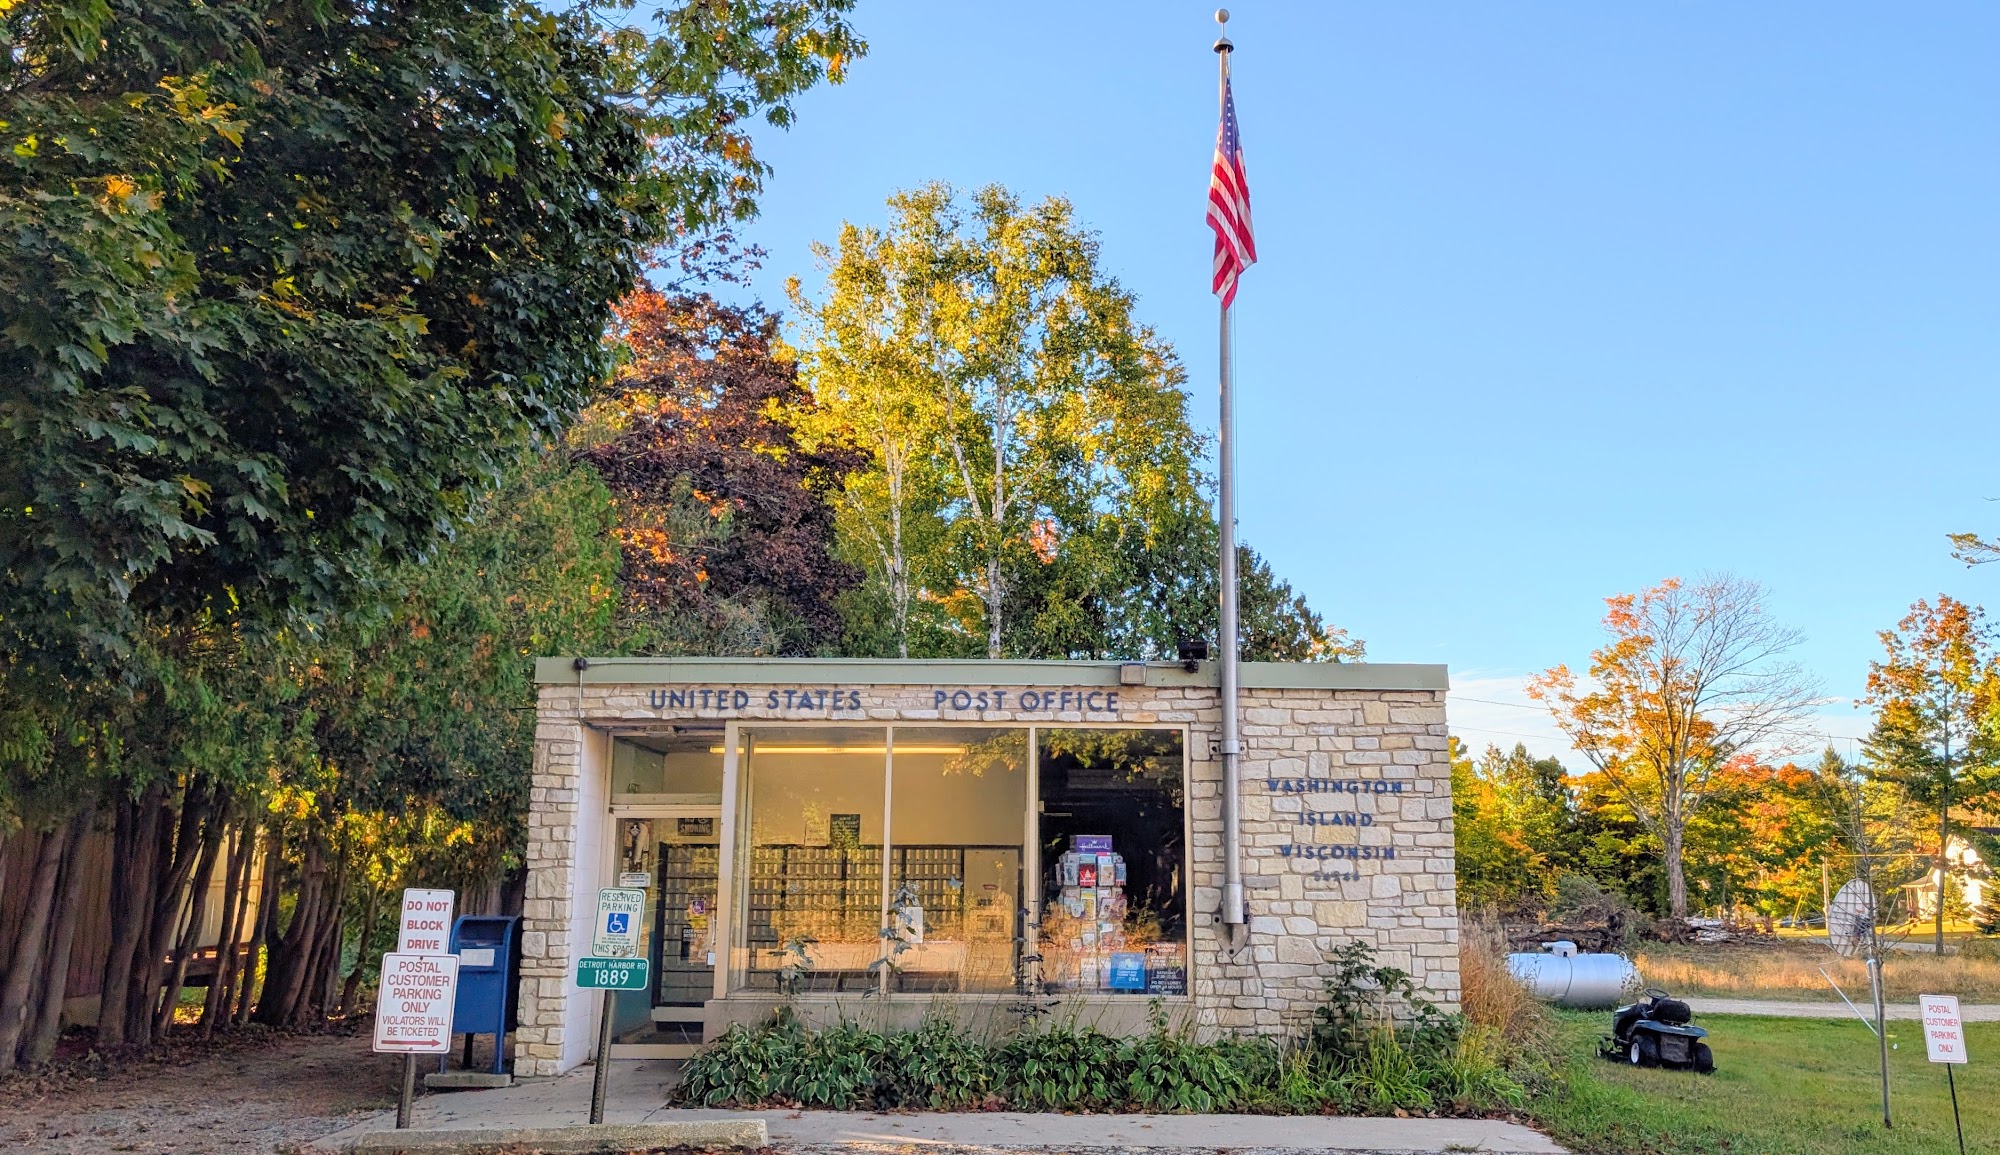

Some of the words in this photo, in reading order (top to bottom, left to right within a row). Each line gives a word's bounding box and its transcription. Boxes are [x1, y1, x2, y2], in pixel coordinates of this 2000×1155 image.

[651, 689, 749, 710] UNITED
[767, 690, 861, 711] STATES
[934, 690, 1007, 711] POST
[1019, 691, 1119, 712] OFFICE
[1267, 779, 1402, 794] WASHINGTON
[680, 824, 711, 833] SMOKING
[1079, 842, 1110, 851] Hallmark
[1280, 844, 1395, 860] WISCONSIN
[601, 892, 641, 903] RESERVED
[407, 901, 423, 911] DO
[426, 902, 449, 911] NOT
[601, 903, 638, 912] PARKING
[407, 920, 444, 930] BLOCK
[407, 939, 440, 949] DRIVE
[594, 944, 610, 953] THIS
[612, 945, 636, 954] SPACE
[399, 961, 441, 973] POSTAL
[579, 961, 606, 969] DETROIT
[608, 961, 636, 970] HARBOR
[637, 962, 646, 970] RD
[387, 974, 450, 987] CUSTOMER
[595, 969, 629, 985] 1889
[392, 988, 442, 1000] PARKING
[401, 1001, 430, 1013] ONLY
[1928, 1005, 1952, 1014] POSTAL
[382, 1015, 425, 1026] VIOLATORS
[428, 1016, 446, 1026] WILL
[1926, 1017, 1959, 1027] CUSTOMER
[387, 1027, 398, 1036] BE
[400, 1027, 439, 1036] TICKETED
[1931, 1030, 1957, 1040] PARKING
[1938, 1043, 1954, 1053] ONLY
